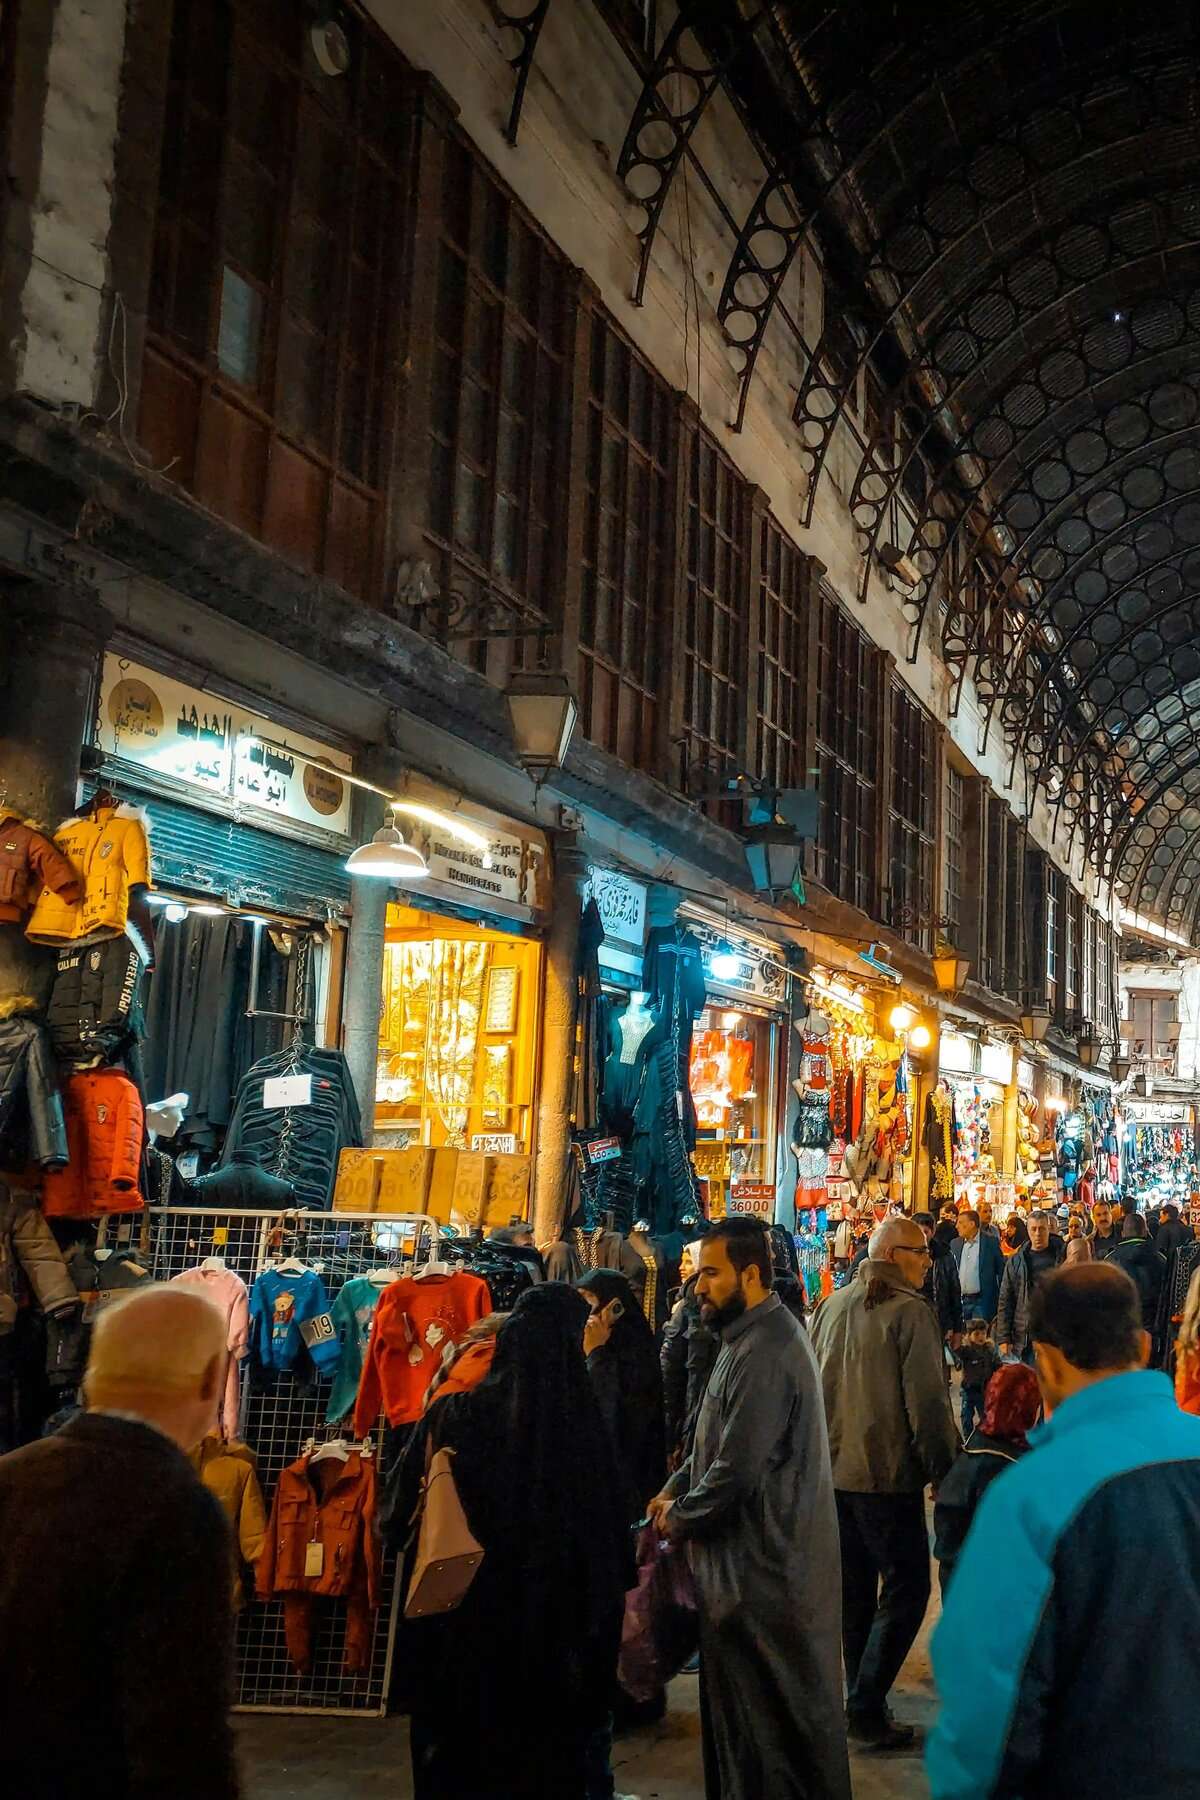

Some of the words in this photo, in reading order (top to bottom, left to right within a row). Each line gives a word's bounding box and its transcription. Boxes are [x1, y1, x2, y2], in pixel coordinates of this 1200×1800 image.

[267, 781, 287, 808] أبو
[124, 951, 140, 988] GREEN
[733, 1186, 761, 1198] بلاش
[730, 1200, 769, 1213] 36000
[311, 1315, 333, 1339] 19
